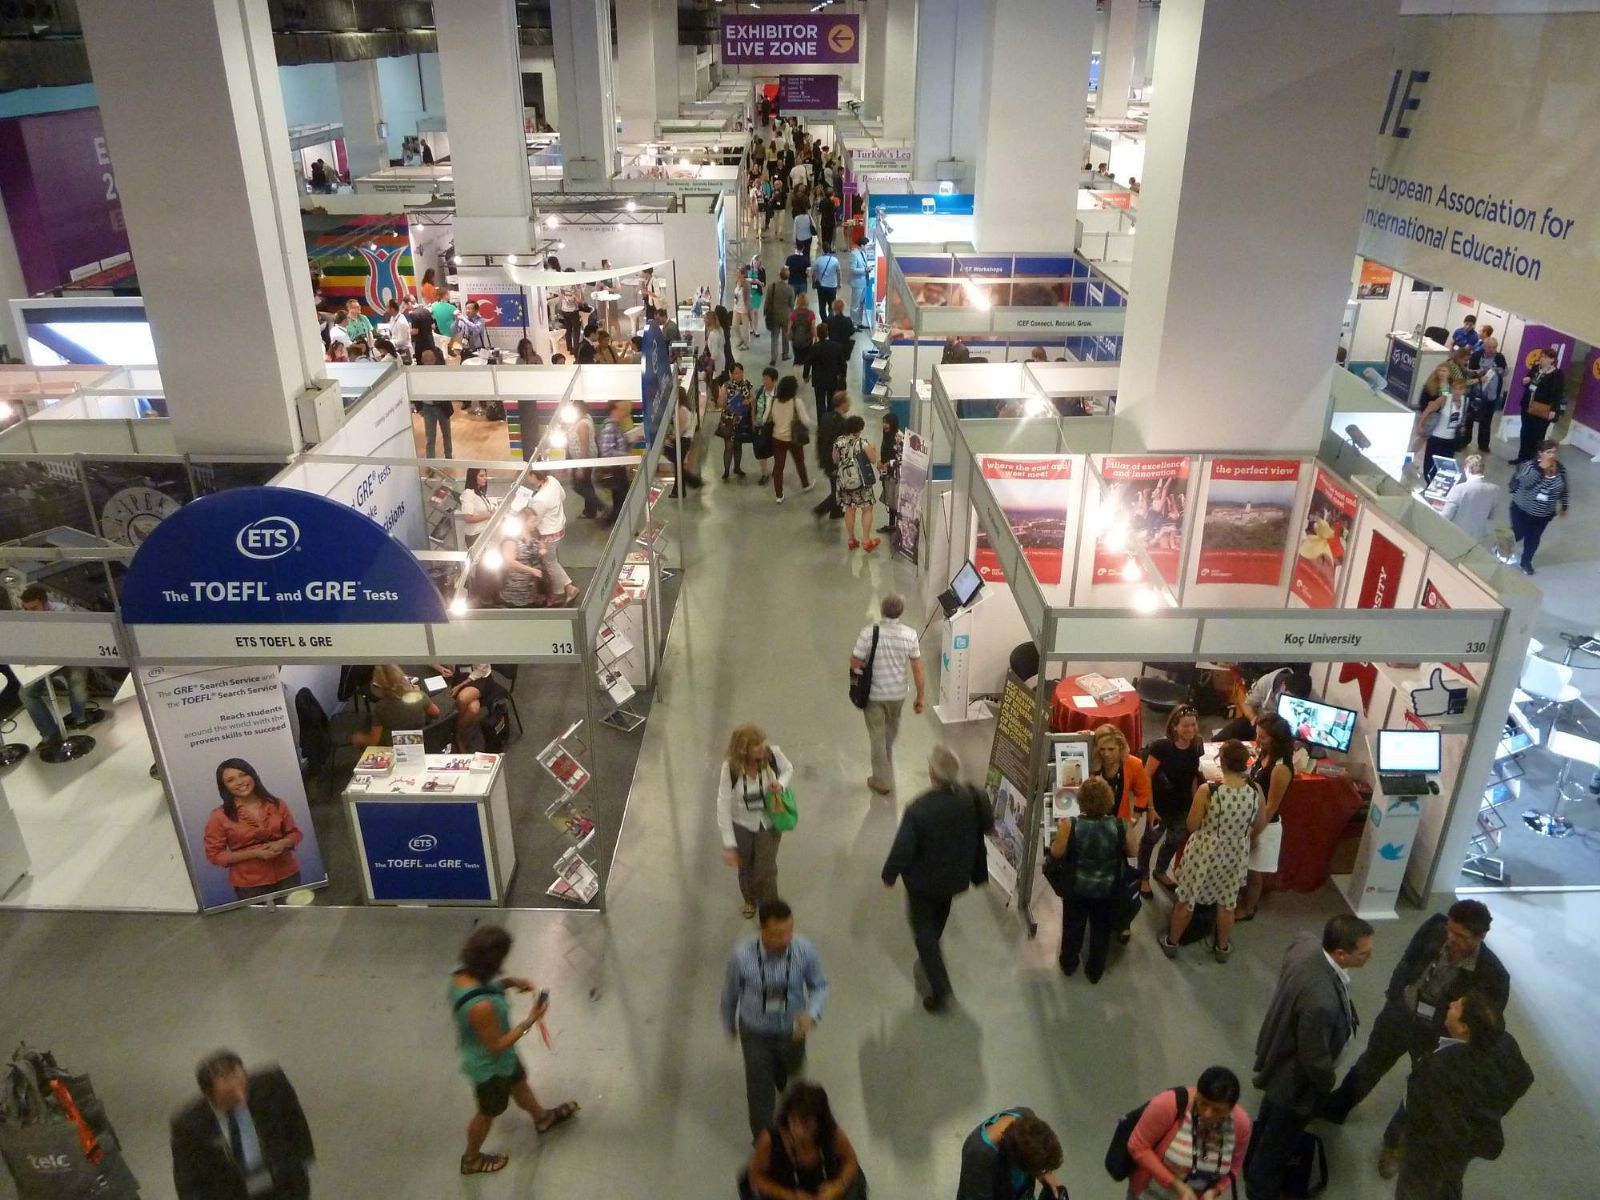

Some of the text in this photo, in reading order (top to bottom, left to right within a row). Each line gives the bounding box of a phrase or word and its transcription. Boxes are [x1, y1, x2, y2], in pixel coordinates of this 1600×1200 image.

[726, 24, 818, 39] EXHIBITOR
[727, 42, 817, 56] LIVE ZONE
[1369, 167, 1575, 240] European Association for
[1451, 230, 1541, 280] Education
[987, 462, 1014, 470] where
[1131, 462, 1141, 470] of
[1142, 460, 1186, 470] excellence
[1216, 465, 1295, 476] the perfect view
[378, 464, 392, 484] tests
[1131, 470, 1176, 478] innovation
[248, 529, 288, 547] ETS
[162, 591, 189, 602] The
[276, 590, 302, 601] and
[363, 590, 398, 601] Tests
[236, 636, 333, 647] ETS TOEFL & GRE
[1284, 633, 1362, 647] Koç University
[99, 645, 118, 656] 314
[552, 643, 572, 653] 313
[1466, 642, 1486, 654] 330
[200, 680, 229, 691] Search
[230, 675, 260, 686] Service
[262, 672, 275, 681] and
[218, 689, 246, 699] Search
[247, 683, 278, 694] Service
[220, 705, 282, 722] Reach students
[184, 714, 284, 739] around the world with the
[190, 723, 286, 748] proven skills to succeed
[413, 839, 432, 847] ETS
[387, 859, 422, 868] TOEFL
[438, 859, 462, 868] GRE
[27, 1154, 70, 1169] telc
